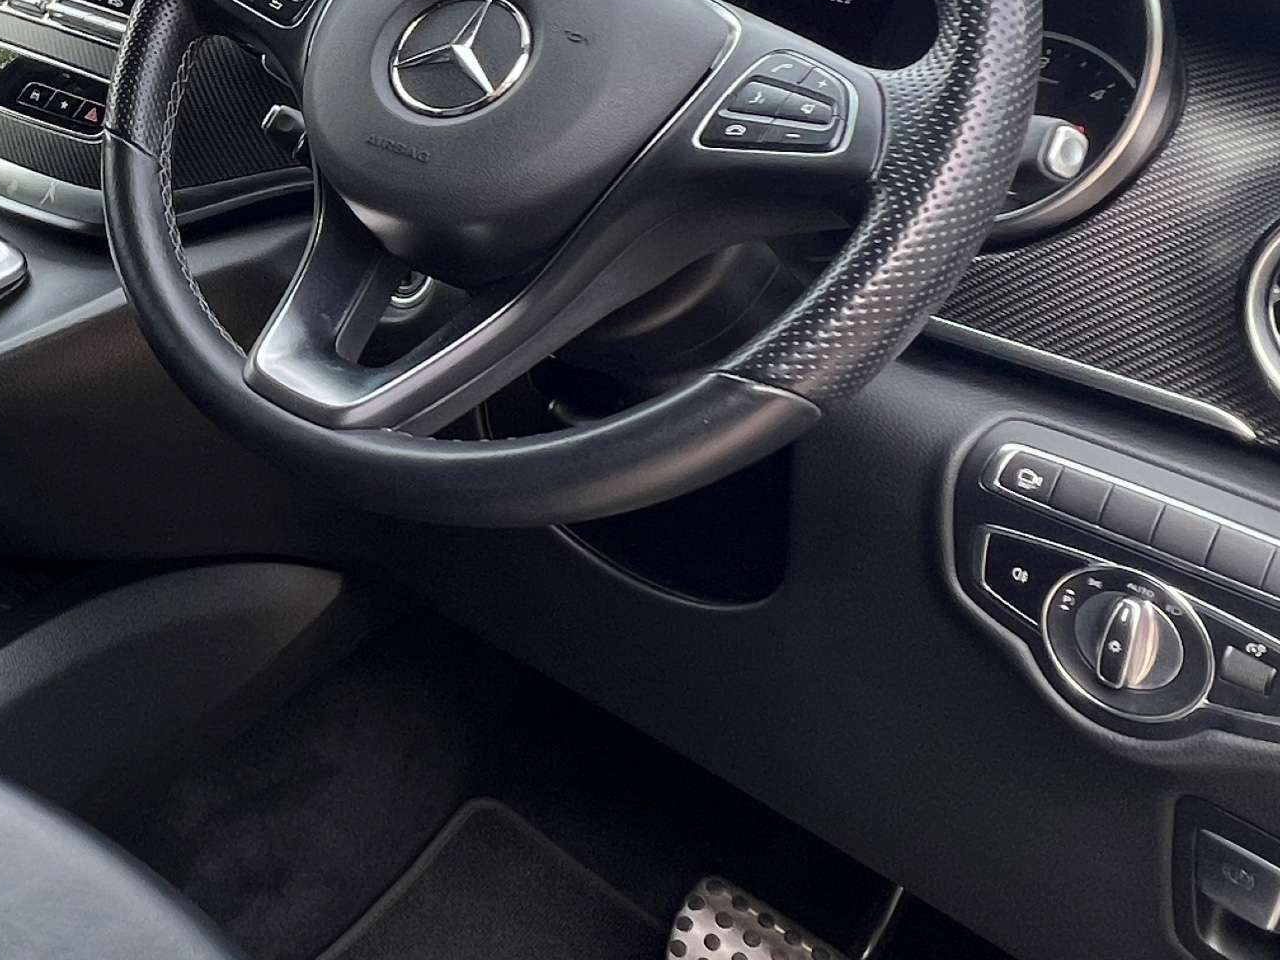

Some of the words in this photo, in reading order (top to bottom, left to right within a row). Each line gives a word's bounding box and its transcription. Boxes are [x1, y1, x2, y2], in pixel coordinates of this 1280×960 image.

[1089, 89, 1107, 101] 4
[366, 133, 431, 163] AIRBAG
[1126, 582, 1155, 599] AUTO
